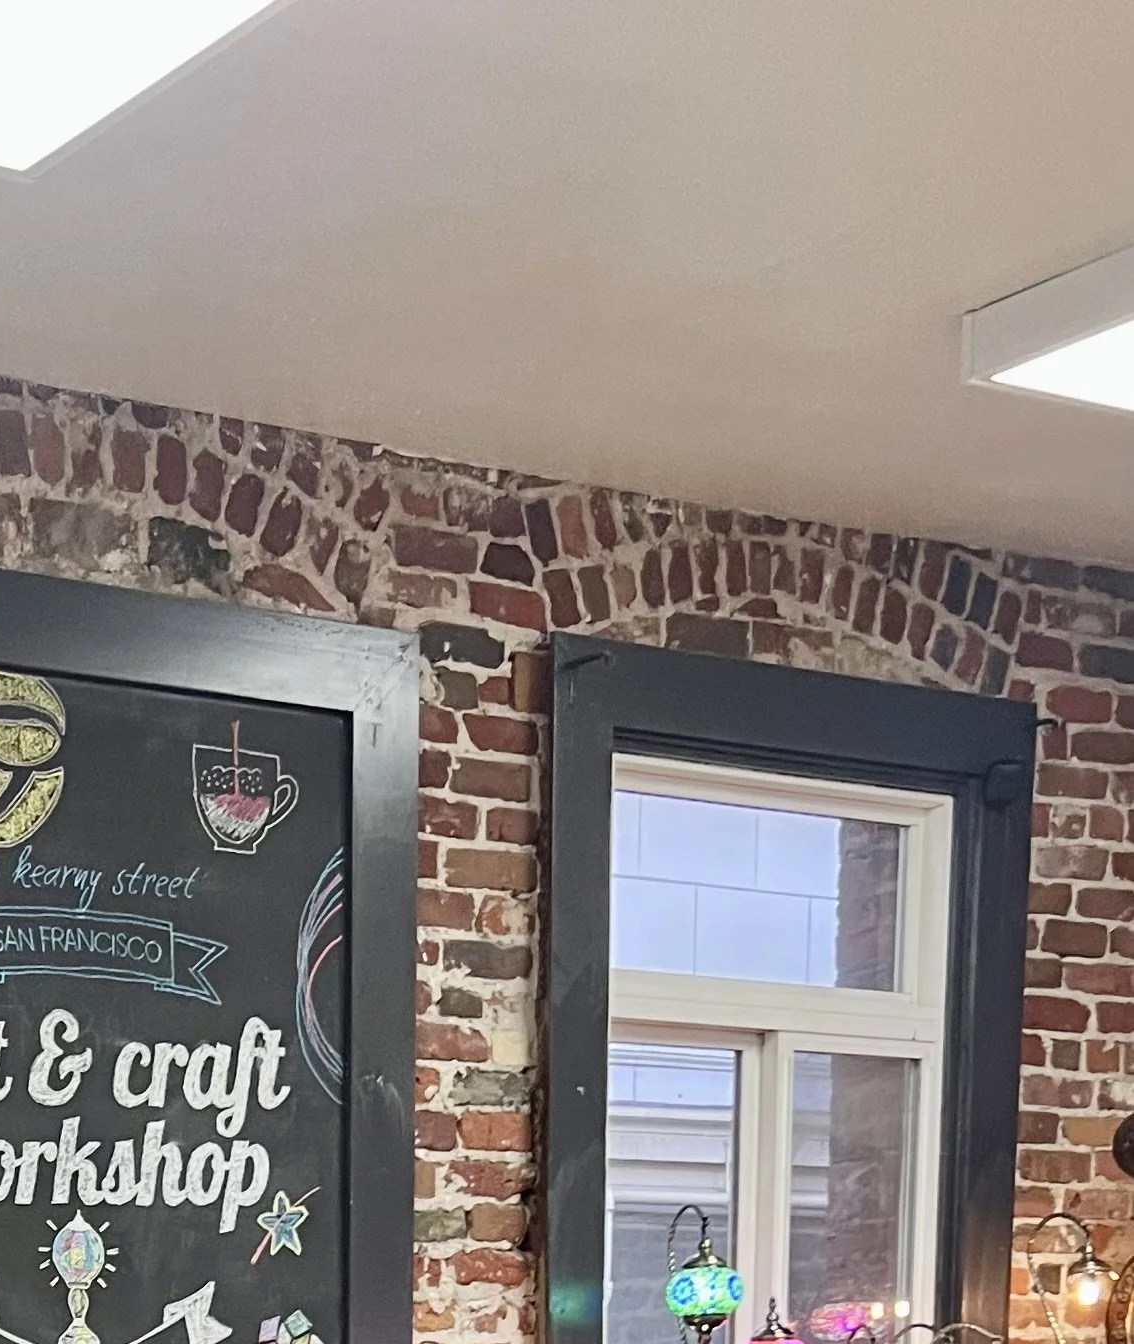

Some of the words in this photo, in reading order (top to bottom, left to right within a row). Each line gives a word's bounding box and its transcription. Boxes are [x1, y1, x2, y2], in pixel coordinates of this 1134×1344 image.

[12, 845, 103, 911] kearny
[111, 862, 201, 899] street
[39, 926, 163, 963] FRANCISCO
[28, 1008, 93, 1106] &
[113, 1016, 291, 1137] craft
